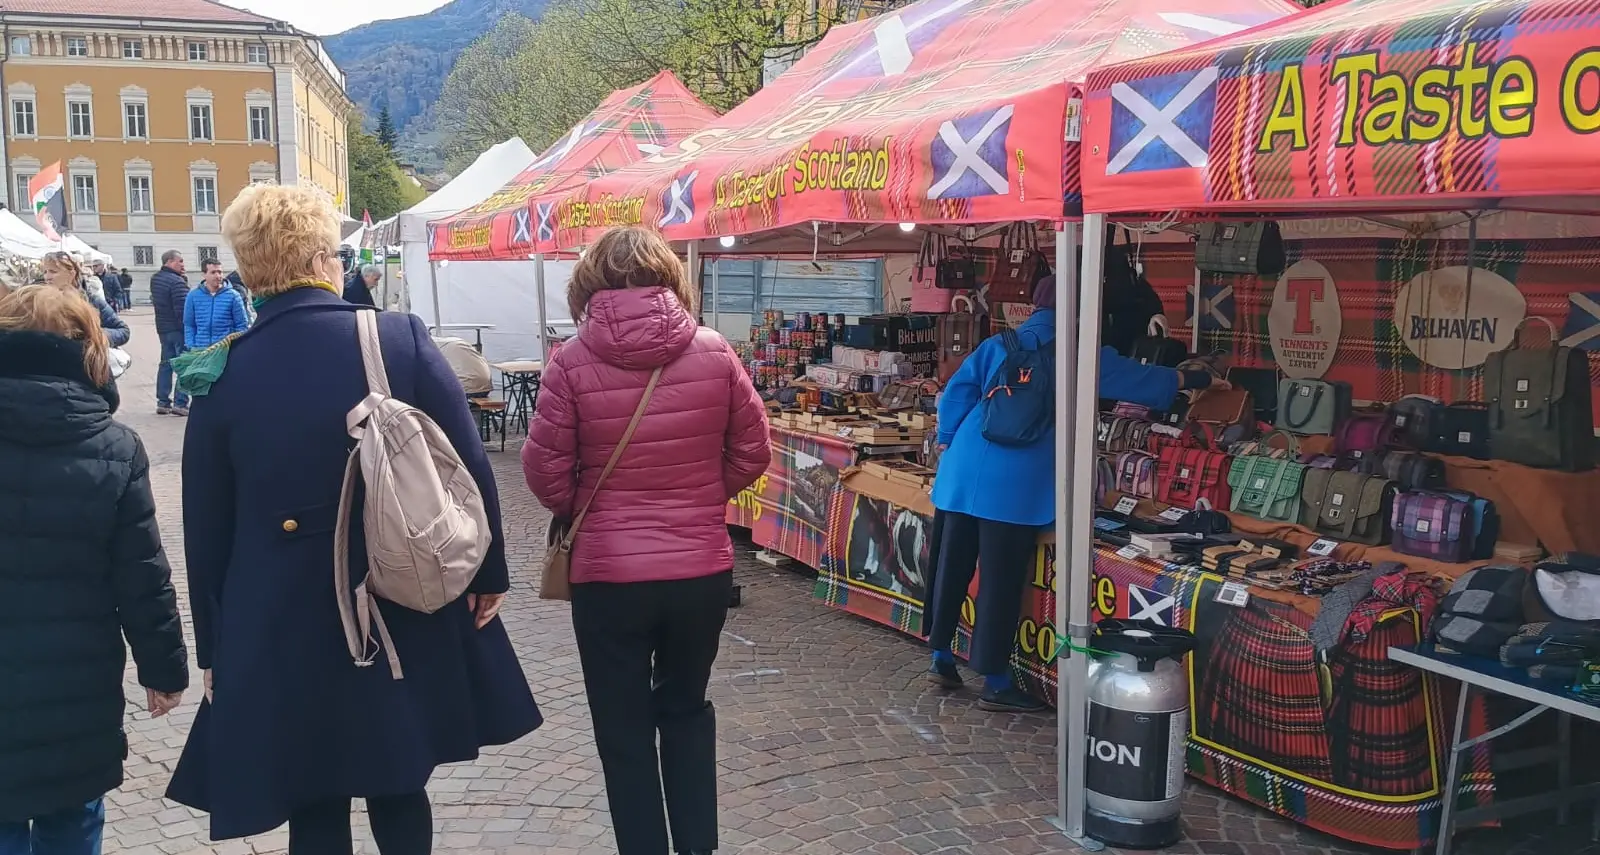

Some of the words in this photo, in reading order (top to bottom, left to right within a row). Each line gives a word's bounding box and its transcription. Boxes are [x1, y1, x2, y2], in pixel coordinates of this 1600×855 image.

[1258, 64, 1307, 151] A
[1330, 42, 1536, 145] Taste
[766, 153, 794, 199] of
[793, 135, 892, 194] Scotland
[1008, 303, 1032, 317] INNIS
[1286, 277, 1325, 335] T
[898, 327, 937, 345] BREWDO
[1410, 315, 1498, 344] BELHAVEN
[904, 351, 932, 363] CHANGE
[1282, 349, 1325, 360] AUTHENTIC
[912, 362, 931, 374] GOOD
[1289, 359, 1318, 369] EXPORT
[1086, 734, 1141, 767] ION
